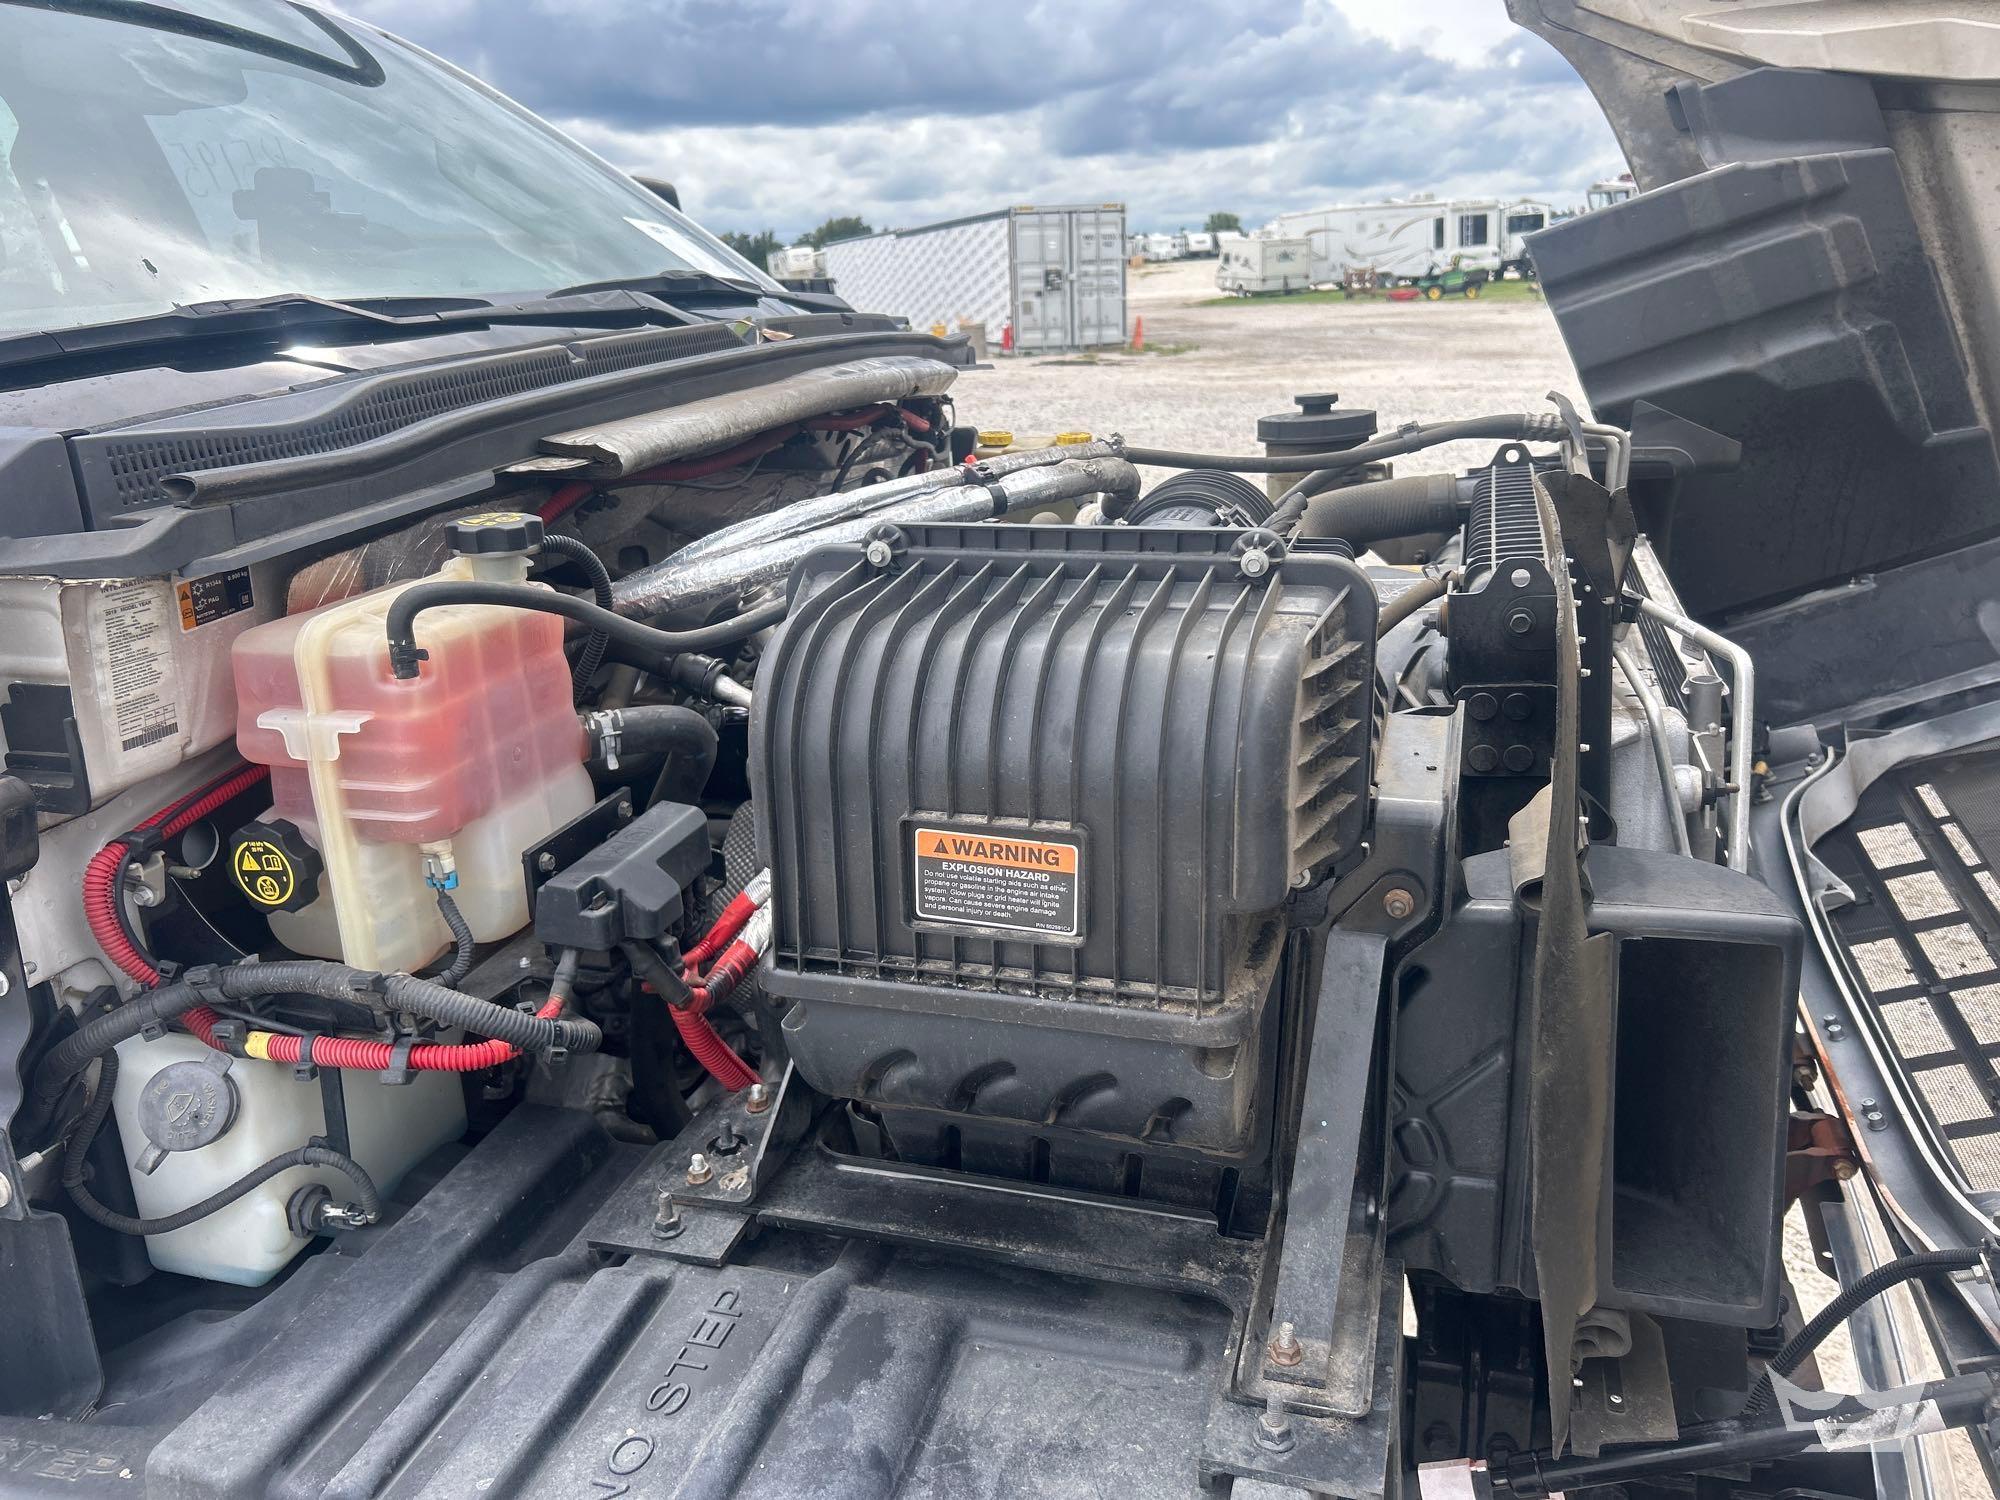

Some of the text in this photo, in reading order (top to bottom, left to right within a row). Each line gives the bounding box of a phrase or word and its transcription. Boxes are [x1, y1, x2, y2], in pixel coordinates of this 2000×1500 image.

[207, 595, 220, 604] PAG
[952, 838, 1059, 867] WARNING
[942, 861, 1049, 882] EXPLOSION HAZARD
[960, 874, 982, 882] volatile
[984, 876, 1007, 887] starting
[1008, 879, 1022, 887] aids
[1023, 881, 1039, 889] such
[924, 879, 950, 888] propane
[960, 882, 986, 893] gasoline
[1007, 887, 1028, 898] engine
[1040, 891, 1059, 899] intake
[950, 889, 966, 897] Glow
[968, 891, 985, 901] plugs
[995, 894, 1007, 903] grid
[1008, 896, 1028, 904] heater
[1042, 900, 1059, 909] ignite
[938, 904, 964, 914] personal
[966, 907, 983, 917] injury
[993, 910, 1012, 918] death.
[1007, 904, 1028, 914] engine
[1030, 906, 1056, 917] damage
[200, 1081, 217, 1128] WASHER
[645, 1287, 743, 1416] STEP
